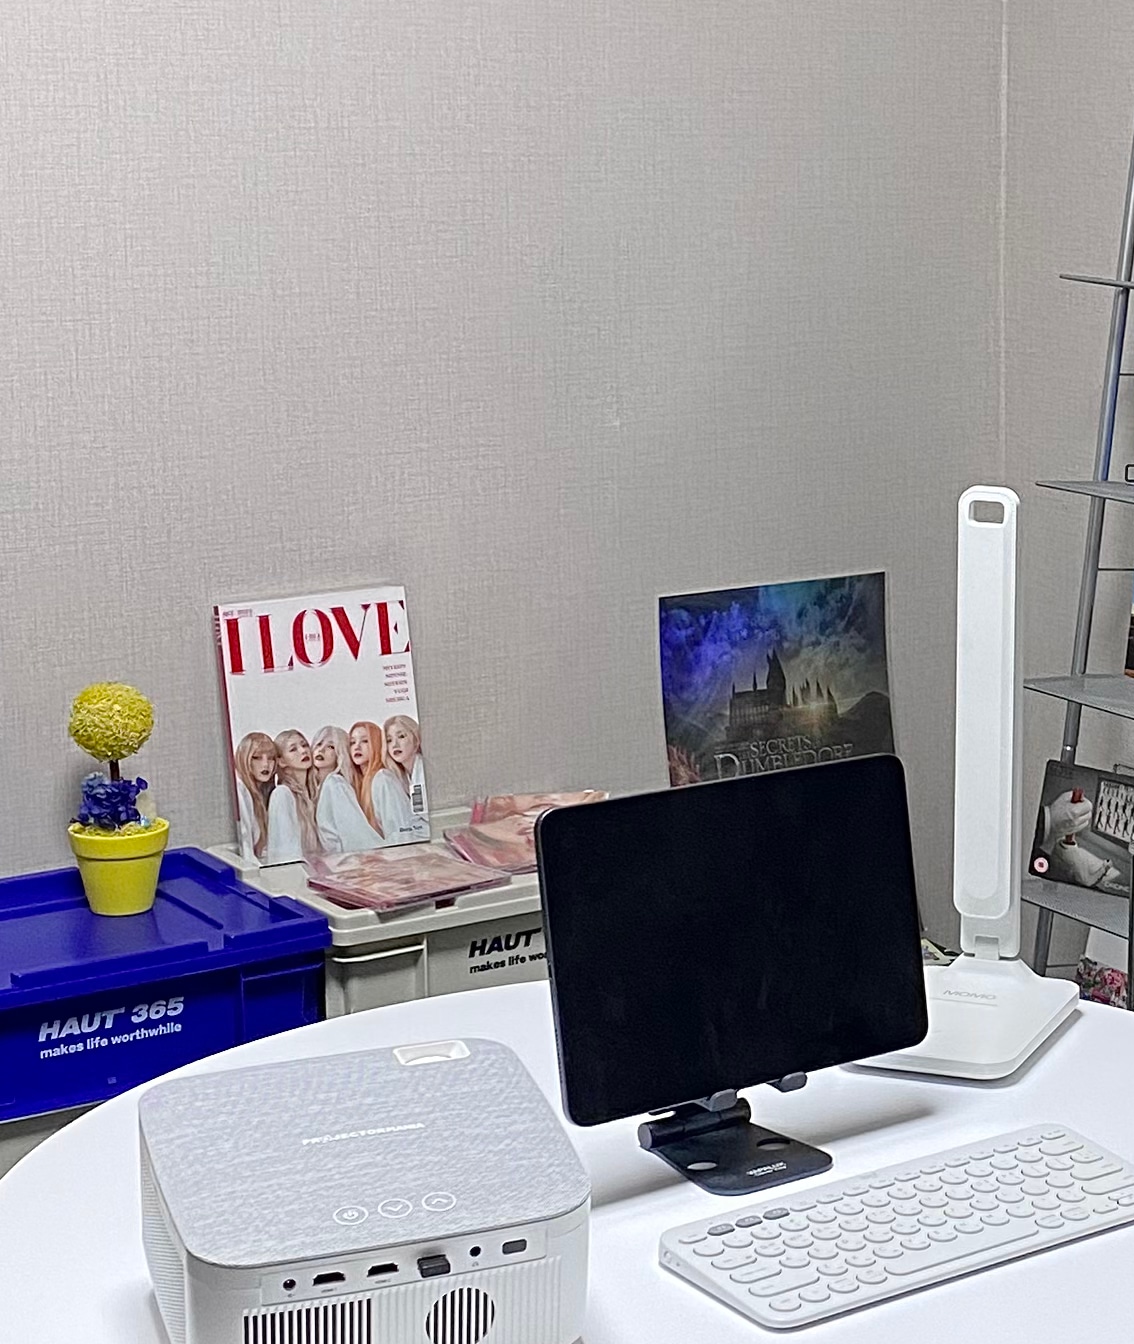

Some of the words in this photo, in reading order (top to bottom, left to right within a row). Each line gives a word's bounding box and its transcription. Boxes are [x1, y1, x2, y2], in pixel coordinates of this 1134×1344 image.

[224, 617, 246, 676] I
[257, 599, 411, 675] LOVE
[749, 735, 812, 758] SECRETS
[468, 927, 543, 959] HAUT
[469, 960, 506, 974] makes
[508, 954, 526, 967] life
[38, 1006, 126, 1042] HAUT
[131, 996, 185, 1023] 365
[39, 1043, 85, 1059] makes
[86, 1036, 109, 1050] life
[110, 1021, 183, 1045] worthwhile
